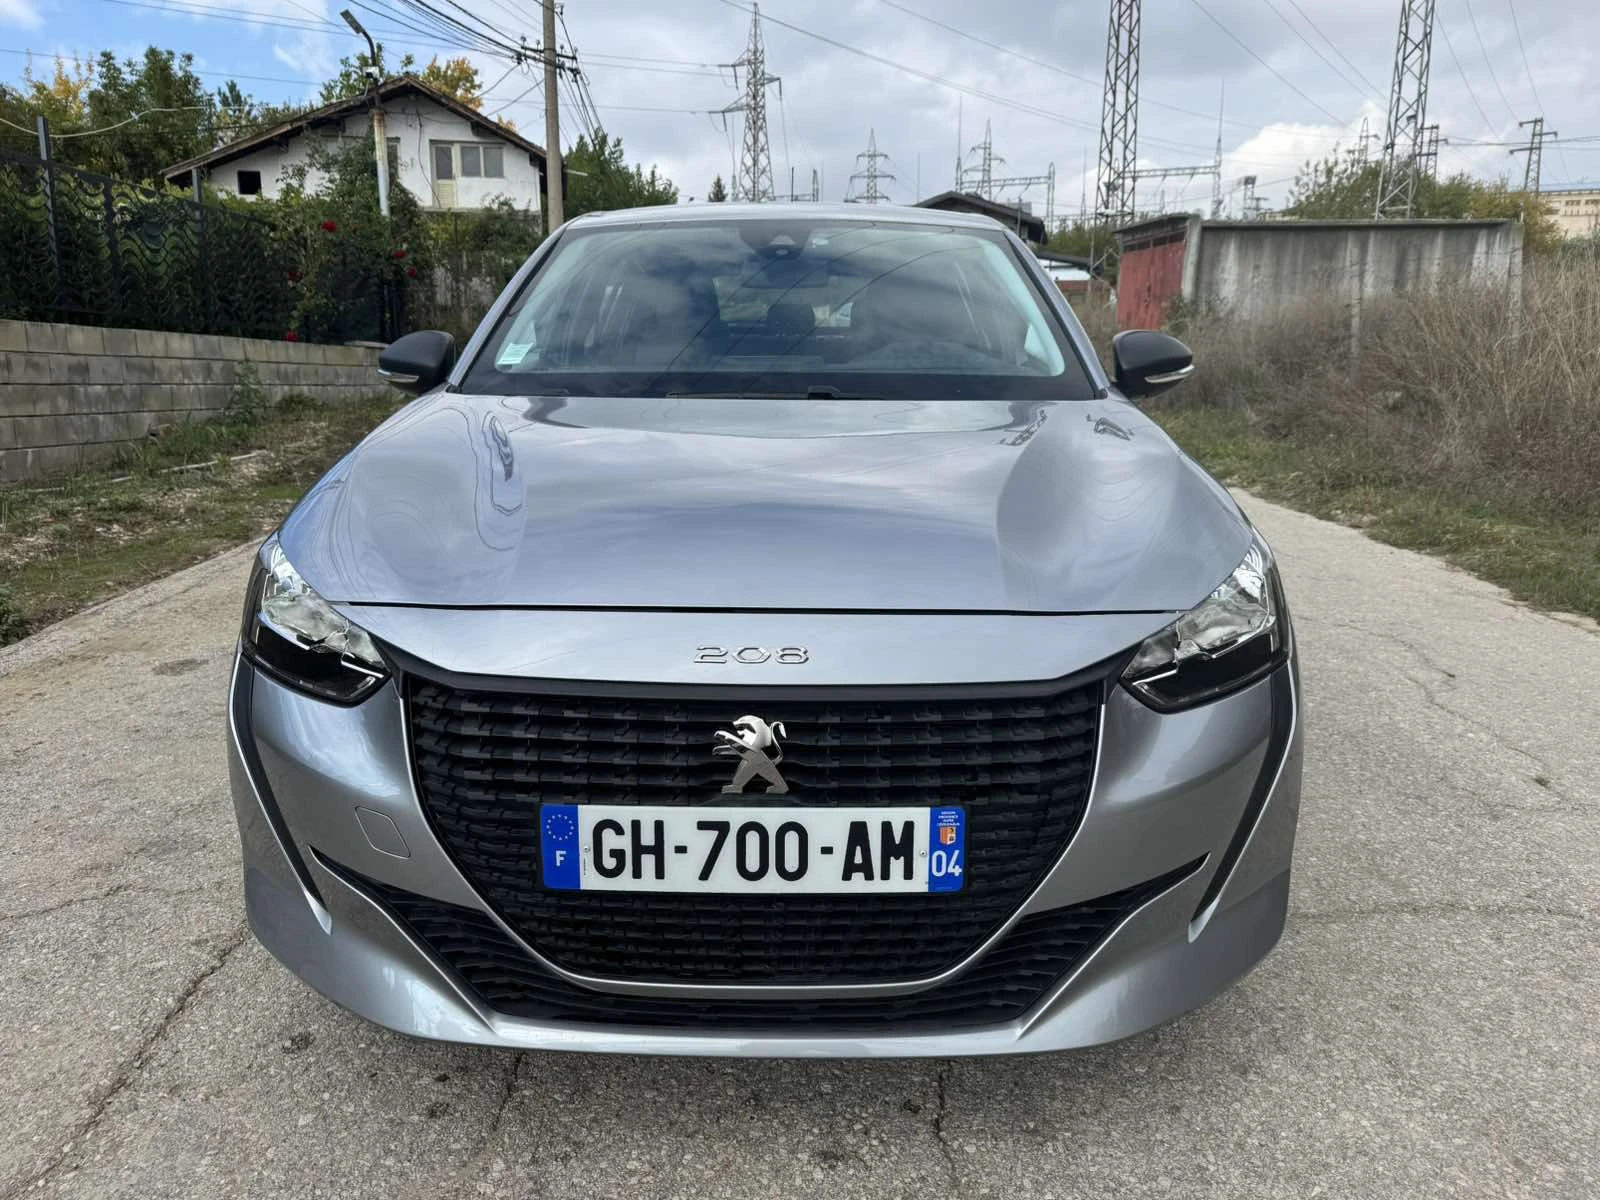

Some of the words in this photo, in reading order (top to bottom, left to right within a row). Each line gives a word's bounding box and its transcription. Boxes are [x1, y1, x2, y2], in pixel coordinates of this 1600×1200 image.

[693, 645, 809, 664] 208
[555, 849, 567, 867] F
[592, 818, 915, 882] GH-700-AM
[931, 849, 963, 877] 04
